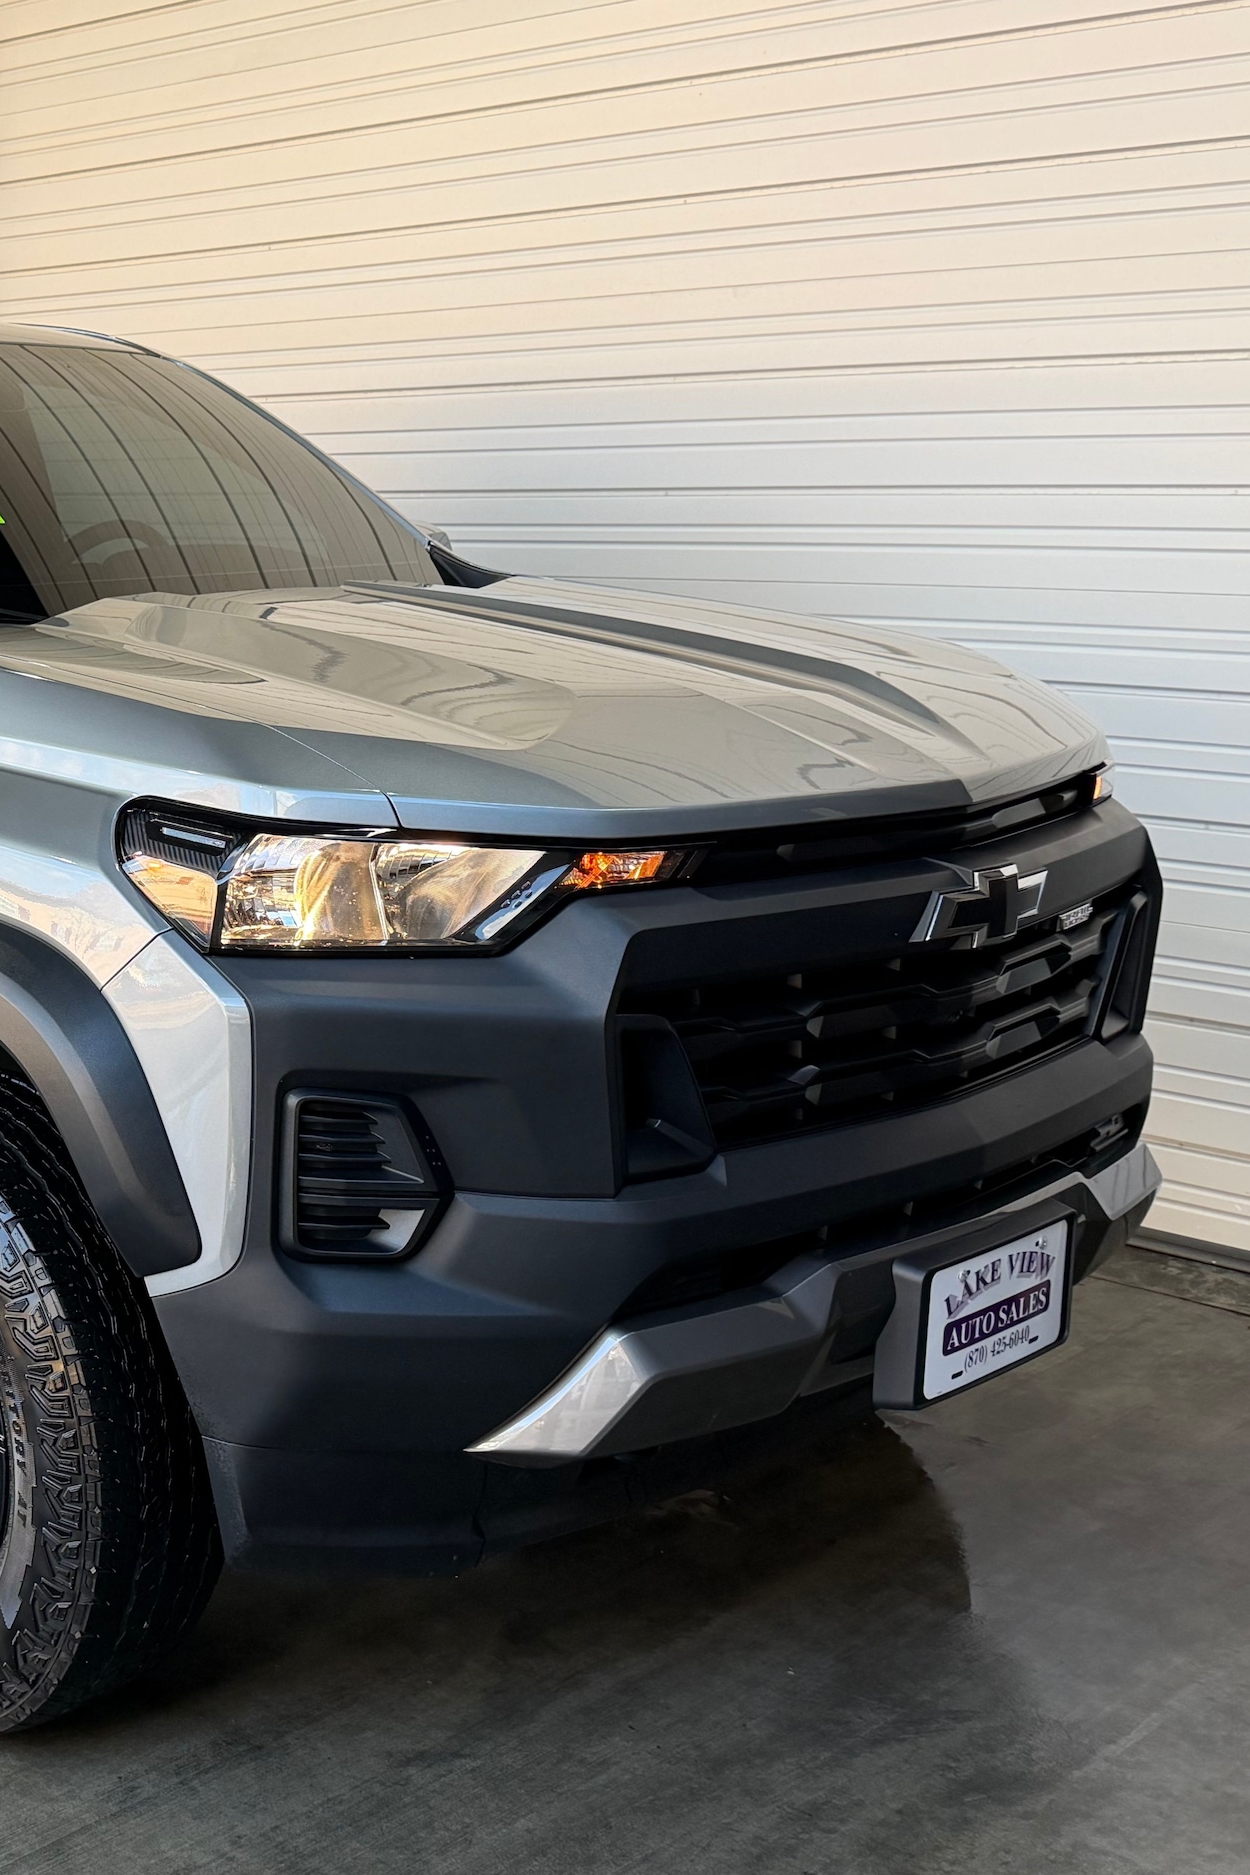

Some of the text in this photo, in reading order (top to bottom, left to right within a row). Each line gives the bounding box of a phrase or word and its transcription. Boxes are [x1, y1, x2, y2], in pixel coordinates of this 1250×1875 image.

[944, 1251, 1056, 1319] LAKE VIEW
[947, 1287, 1047, 1350] AUTO SALES
[964, 1345, 988, 1373] (870)
